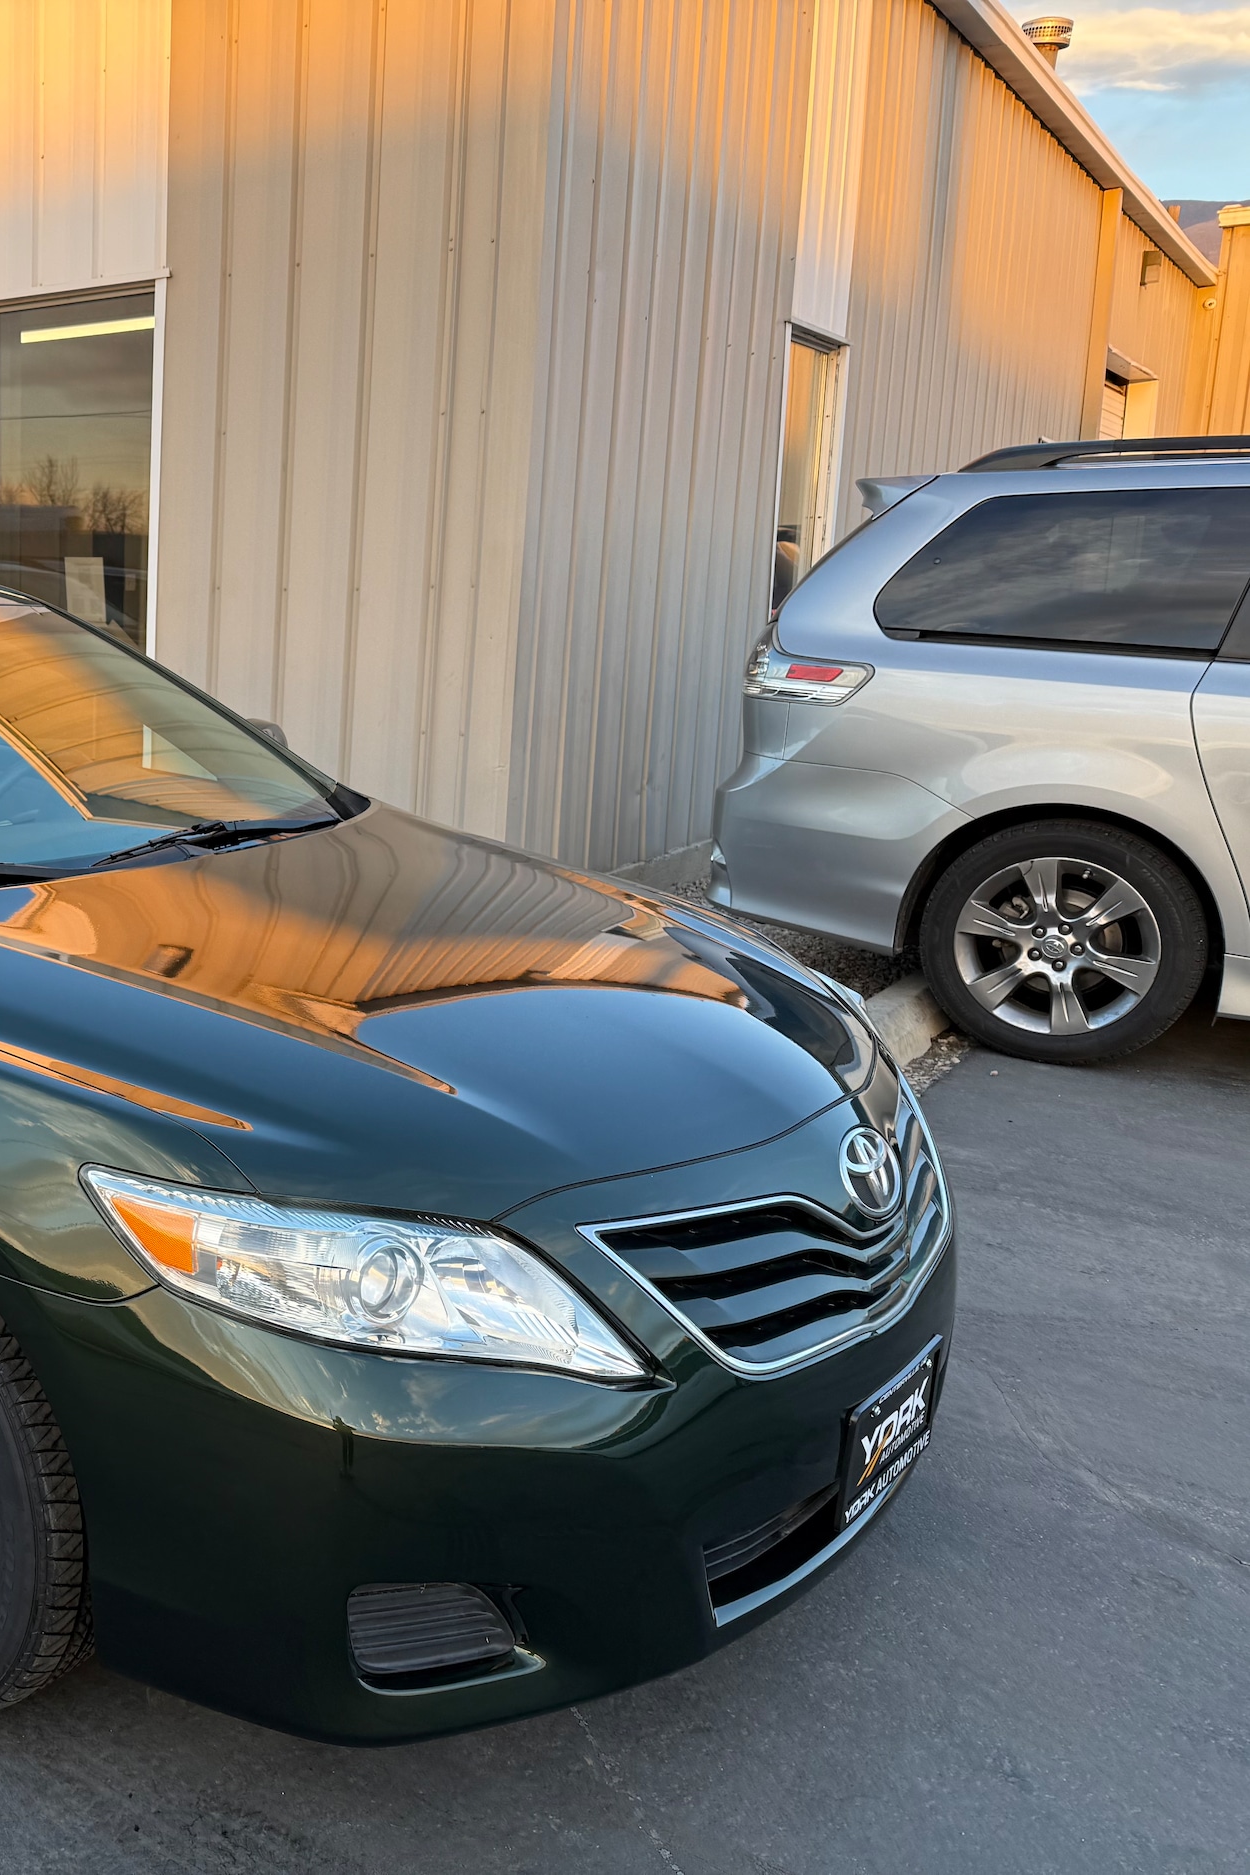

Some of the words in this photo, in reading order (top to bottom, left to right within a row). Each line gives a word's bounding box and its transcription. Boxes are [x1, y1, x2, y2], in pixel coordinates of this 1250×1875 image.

[861, 1376, 929, 1465] YORK
[879, 1411, 925, 1464] AUTOMOTIVE
[844, 1484, 876, 1524] YORK
[875, 1430, 931, 1494] AUTOMOTIVE
